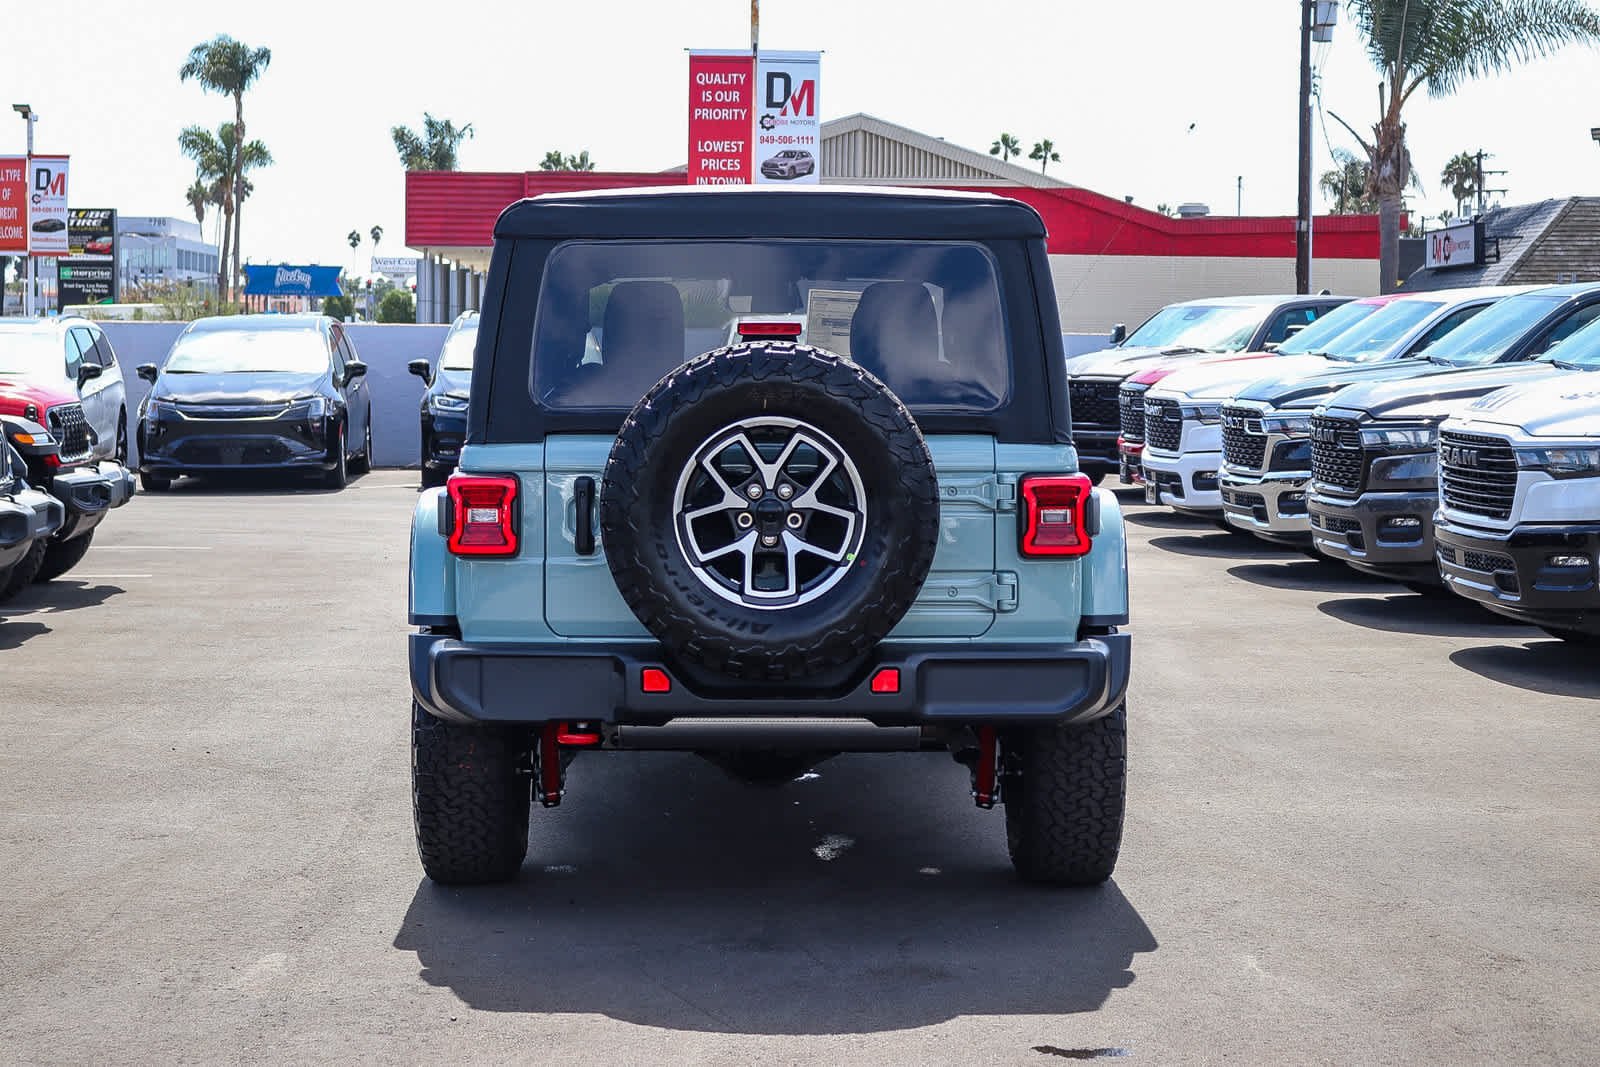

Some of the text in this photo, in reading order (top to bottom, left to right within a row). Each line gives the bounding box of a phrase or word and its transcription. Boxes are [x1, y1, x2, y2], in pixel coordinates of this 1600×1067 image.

[696, 73, 746, 85] QUALITY
[702, 91, 740, 102] IS OUR
[766, 71, 815, 117] DM
[694, 108, 747, 120] PRIORITY
[698, 141, 744, 153] LOWEST
[701, 158, 741, 171] PRICES
[6, 169, 21, 182] TYPE
[696, 176, 746, 185] IN TOWN
[2, 187, 11, 201] OF
[63, 269, 111, 279] enterprise
[1310, 428, 1335, 442] RAM
[1441, 446, 1478, 466] RAM
